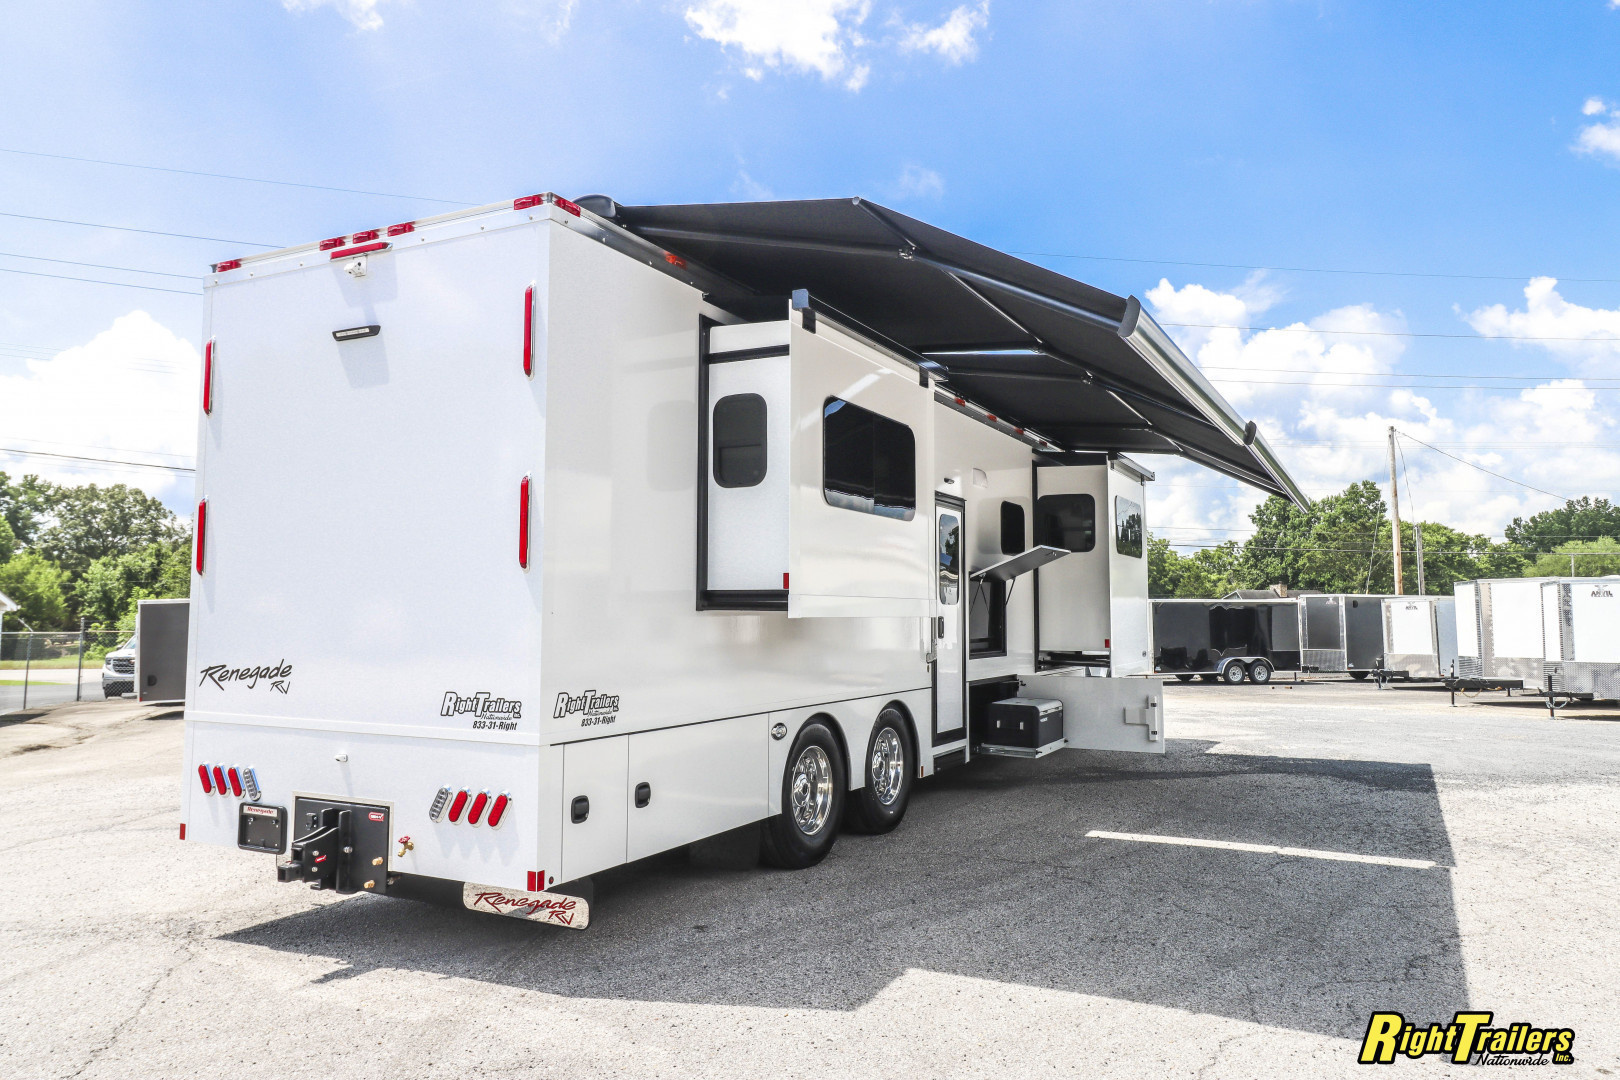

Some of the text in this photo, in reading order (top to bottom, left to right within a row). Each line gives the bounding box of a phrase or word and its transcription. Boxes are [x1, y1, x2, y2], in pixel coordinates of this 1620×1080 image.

[199, 658, 293, 691] Renegade
[269, 679, 291, 695] RV
[472, 720, 518, 732] 833-31-Right
[473, 891, 577, 914] Renegade
[547, 909, 575, 926] RV
